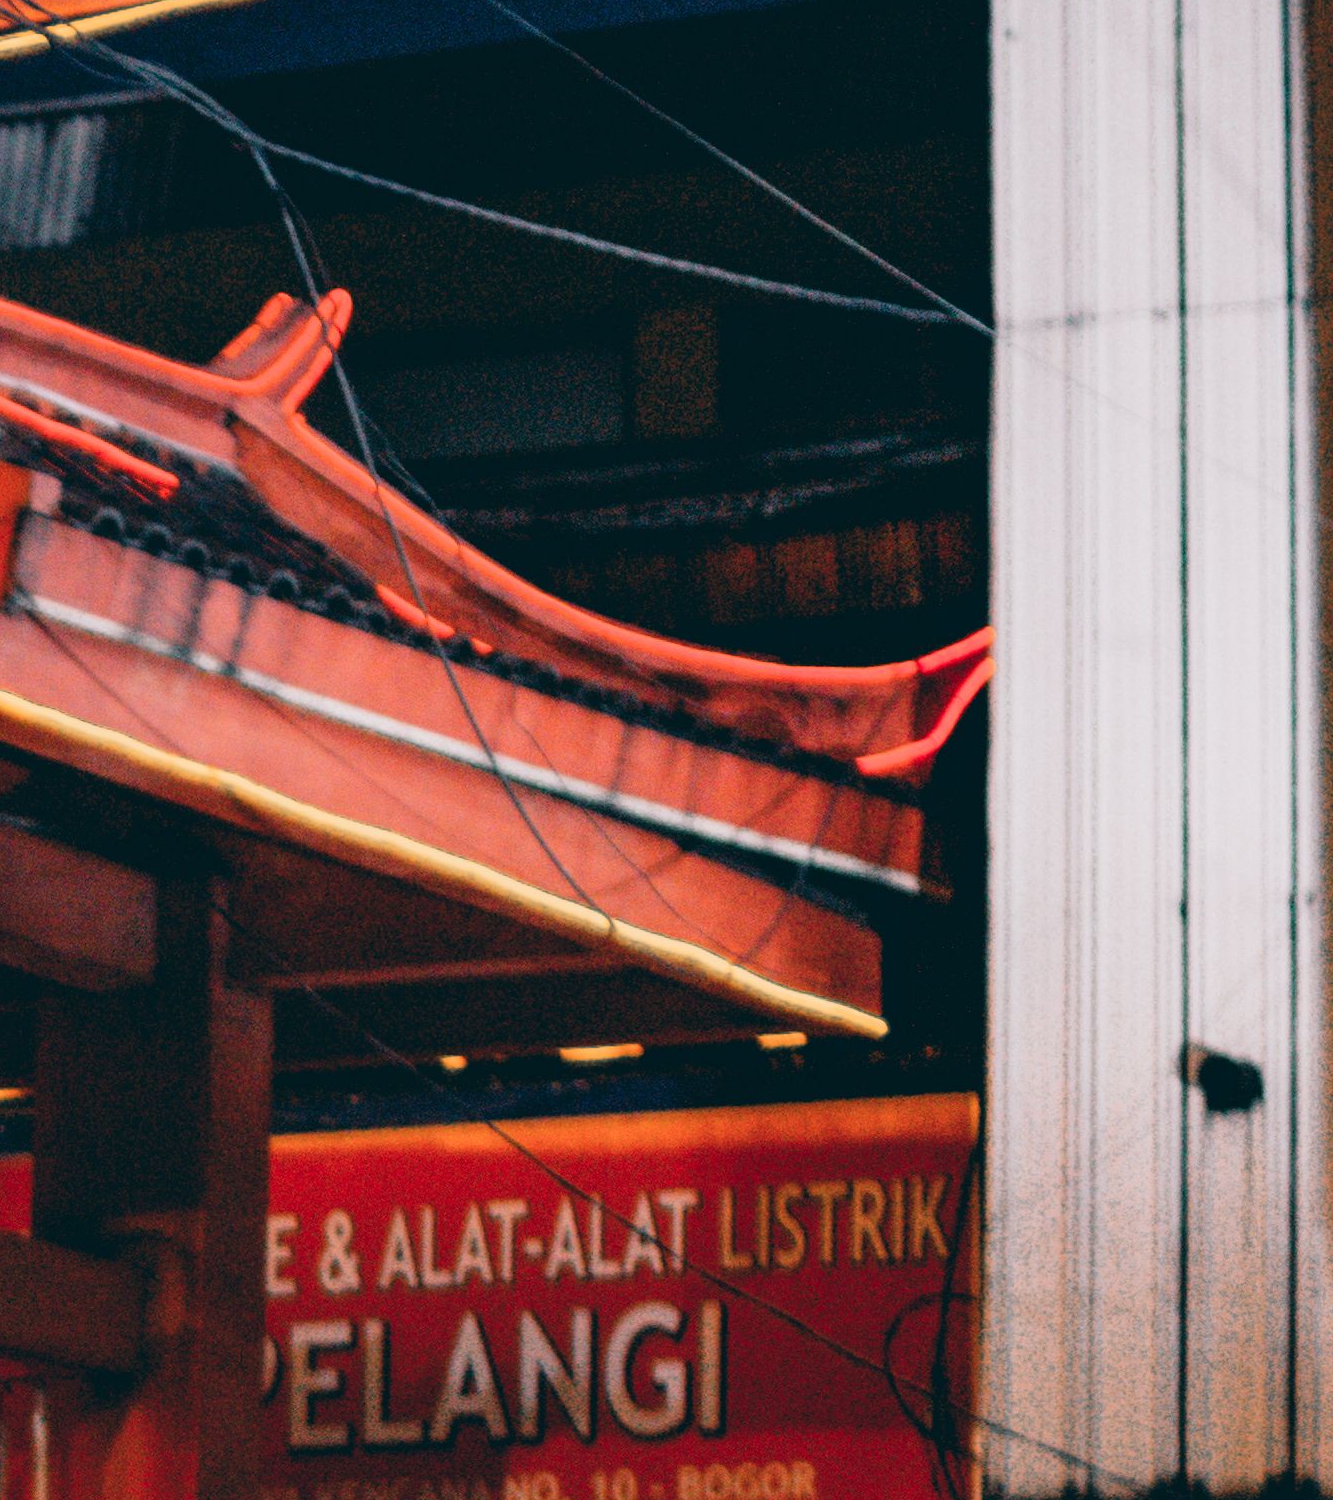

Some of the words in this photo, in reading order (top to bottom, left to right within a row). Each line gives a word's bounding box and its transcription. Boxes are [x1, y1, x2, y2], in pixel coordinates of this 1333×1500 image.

[318, 1210, 361, 1294] &
[379, 1188, 699, 1289] ALAT-ALAT
[719, 1174, 954, 1271] LISTRIK
